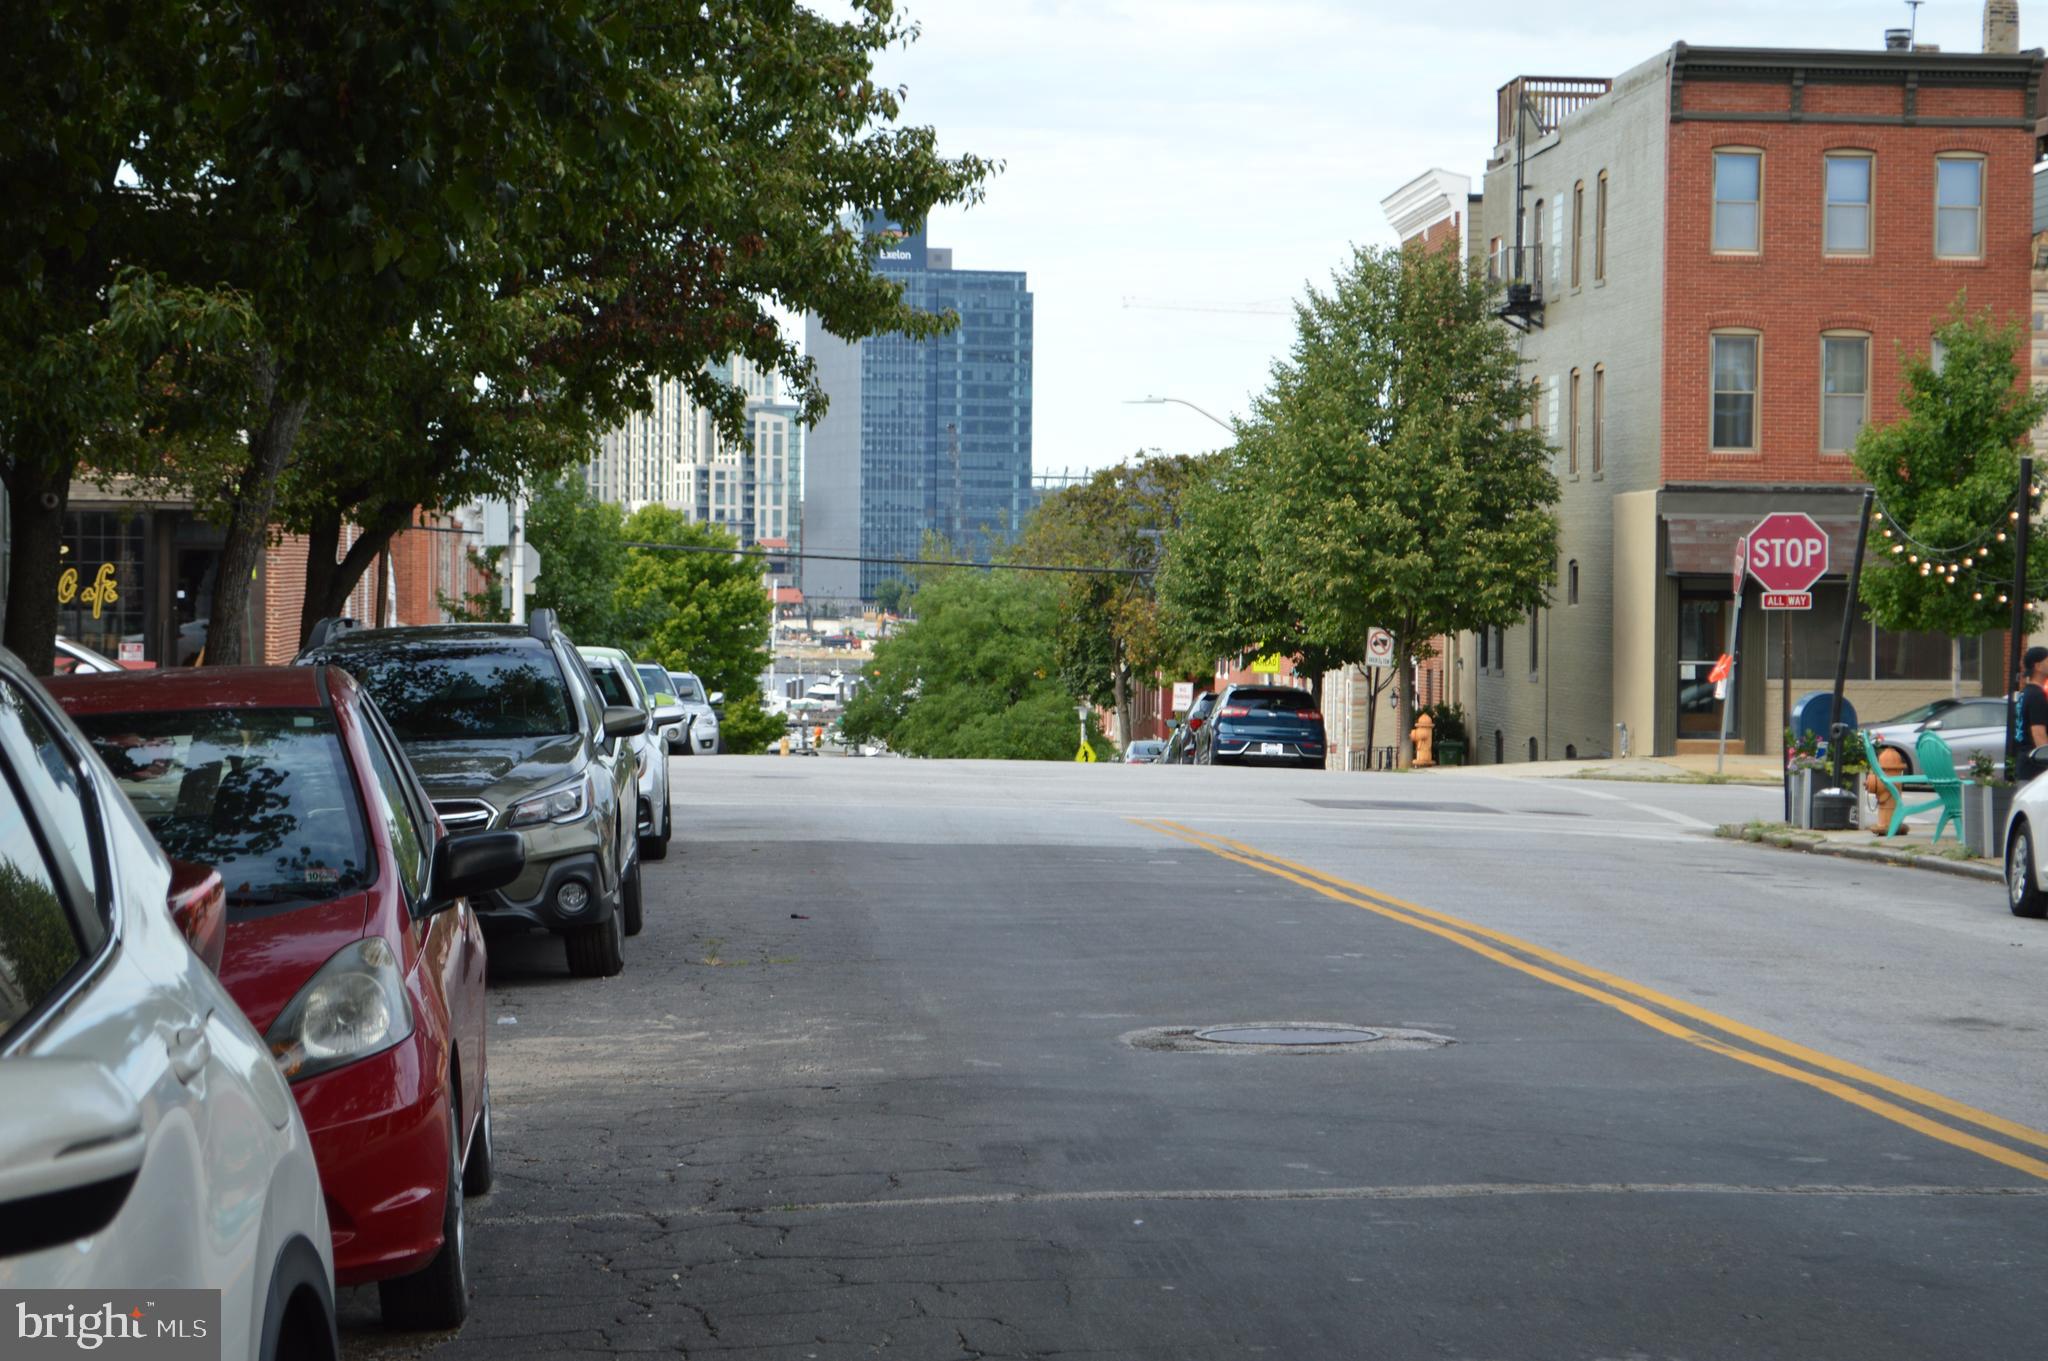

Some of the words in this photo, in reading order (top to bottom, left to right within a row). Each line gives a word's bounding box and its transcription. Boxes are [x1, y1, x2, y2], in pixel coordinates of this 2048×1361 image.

[880, 249, 911, 260] Exelon
[1753, 538, 1822, 568] STOP
[1767, 596, 1785, 606] ALL
[1787, 596, 1807, 606] WAY
